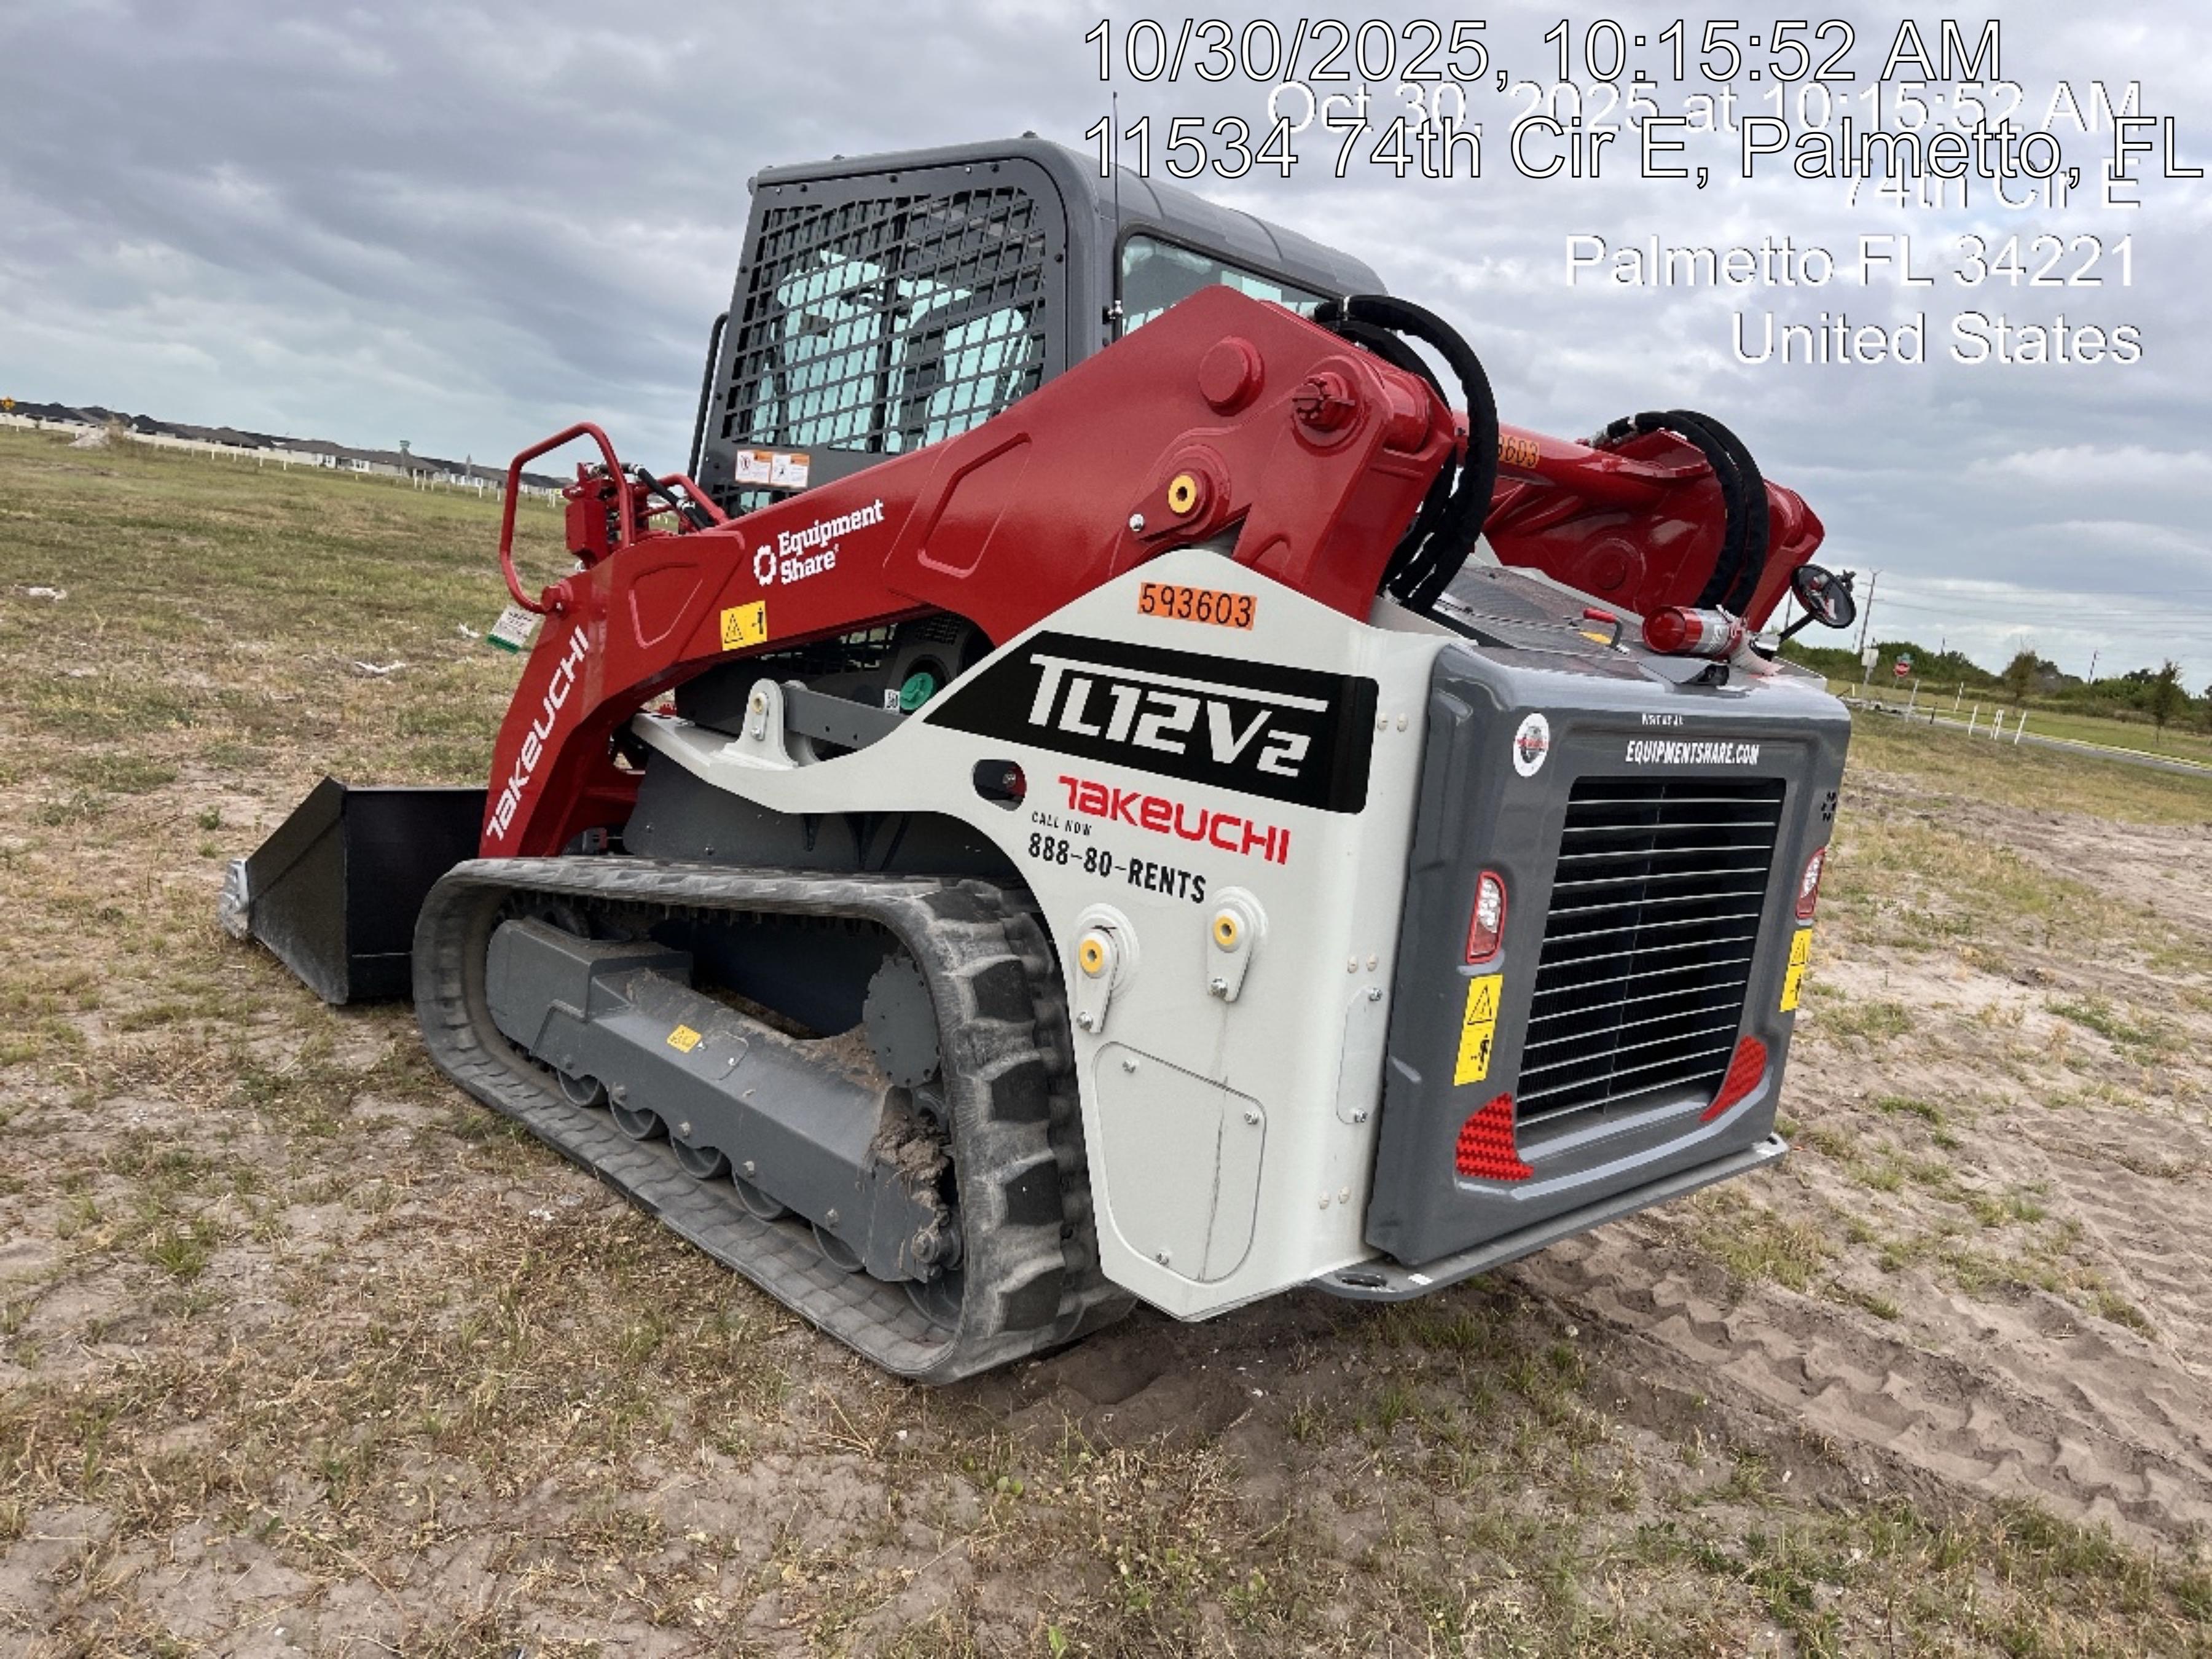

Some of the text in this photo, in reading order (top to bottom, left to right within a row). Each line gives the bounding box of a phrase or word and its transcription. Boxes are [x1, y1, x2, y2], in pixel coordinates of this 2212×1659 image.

[777, 498, 885, 557] Equipment
[1140, 584, 1252, 627] 593603
[1027, 653, 1328, 778] TL12V2
[1625, 740, 1760, 766] EQUIPMENTSHARE.COM
[1032, 810, 1092, 836] CALL NOW
[1028, 832, 1206, 903] 888-80-RENTS
